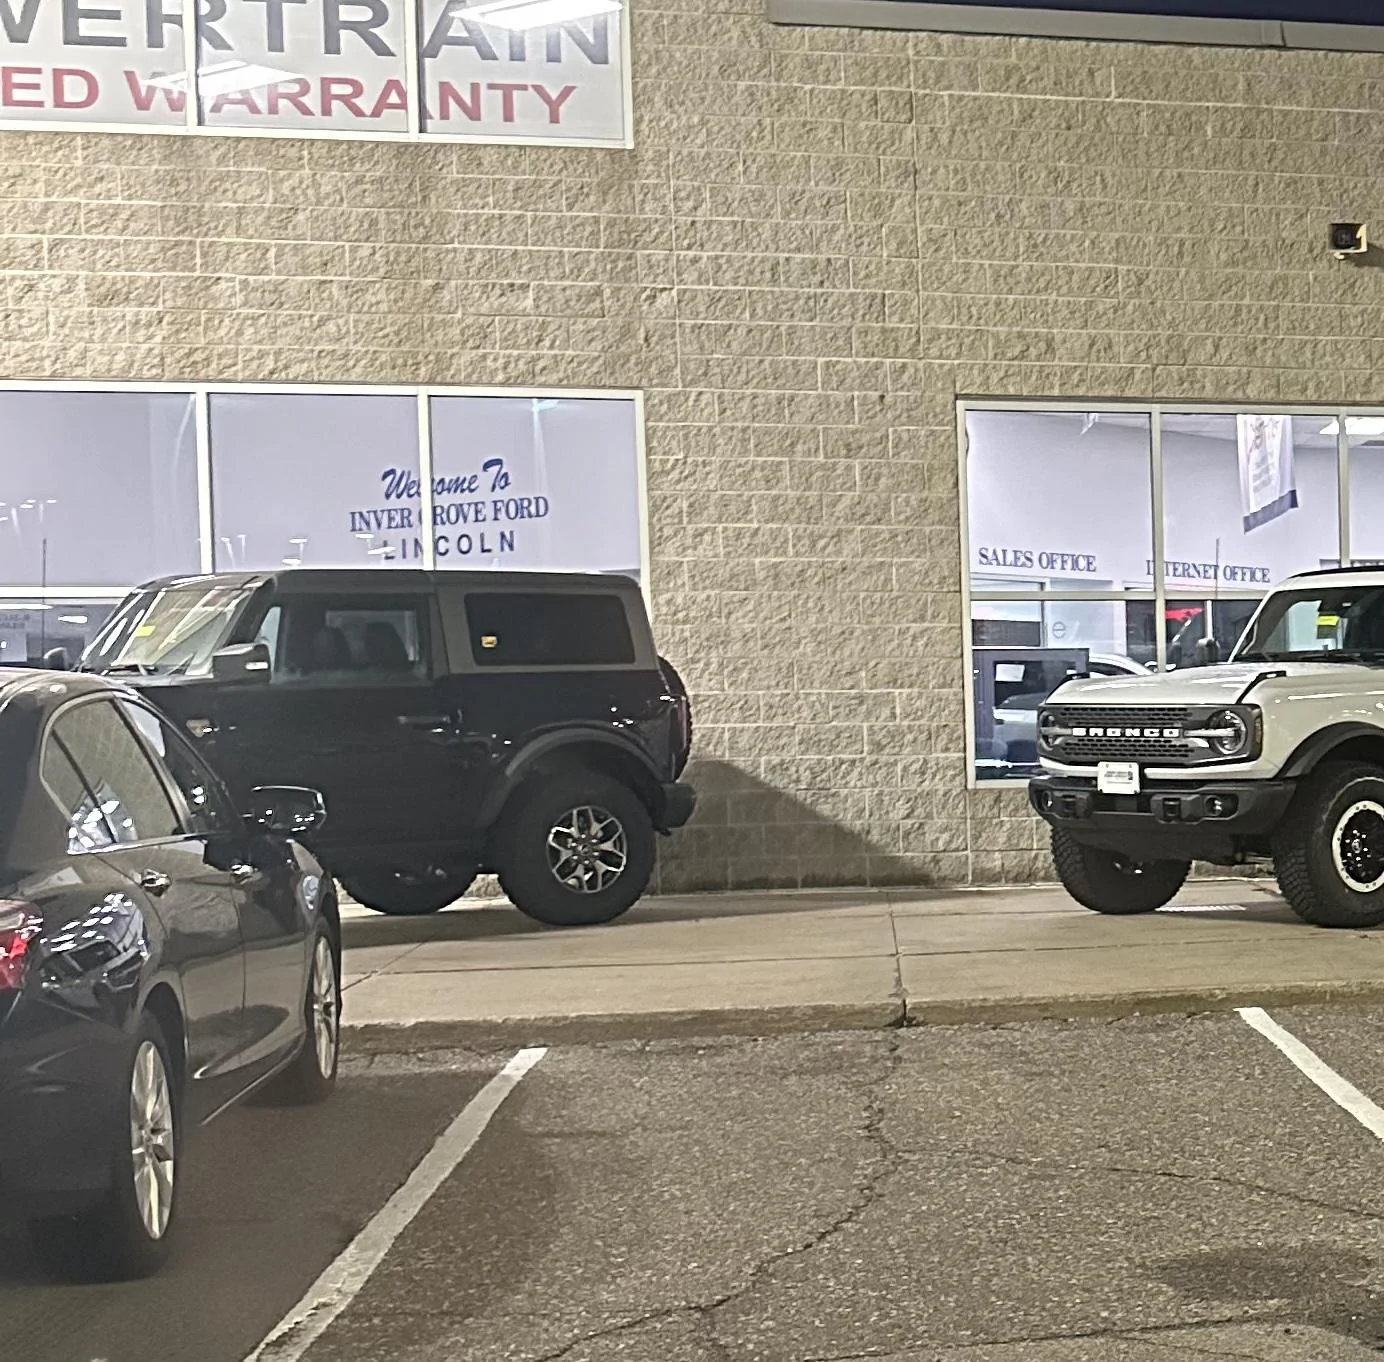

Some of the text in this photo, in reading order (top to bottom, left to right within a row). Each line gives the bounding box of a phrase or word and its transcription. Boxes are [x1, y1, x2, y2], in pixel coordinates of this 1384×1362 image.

[382, 458, 511, 500] Weome To
[350, 496, 549, 532] INVER ROVE FORD
[978, 547, 1097, 572] SALES OFFICE
[1146, 559, 1271, 583] ITERNET OFFICE
[1072, 727, 1180, 738] BRONCO
